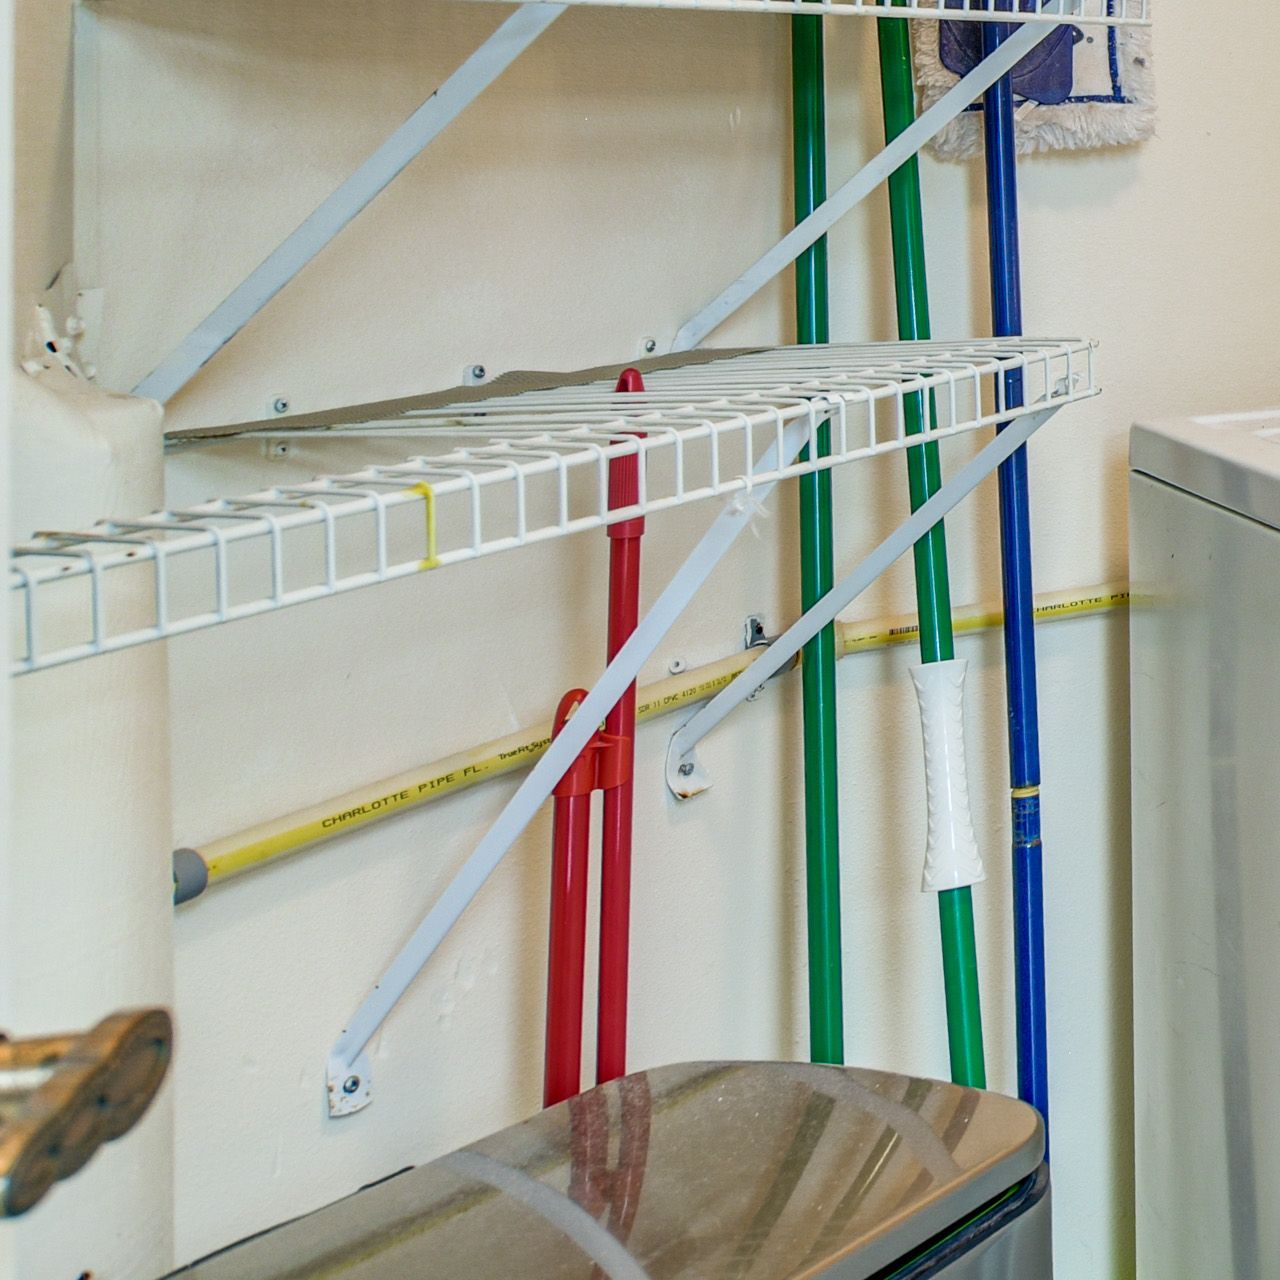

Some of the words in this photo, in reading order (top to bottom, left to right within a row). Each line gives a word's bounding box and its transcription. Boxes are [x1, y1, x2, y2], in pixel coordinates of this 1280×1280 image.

[682, 687, 697, 698] 4120
[321, 790, 410, 829] CHARLOTTE
[417, 772, 456, 793] PIPE
